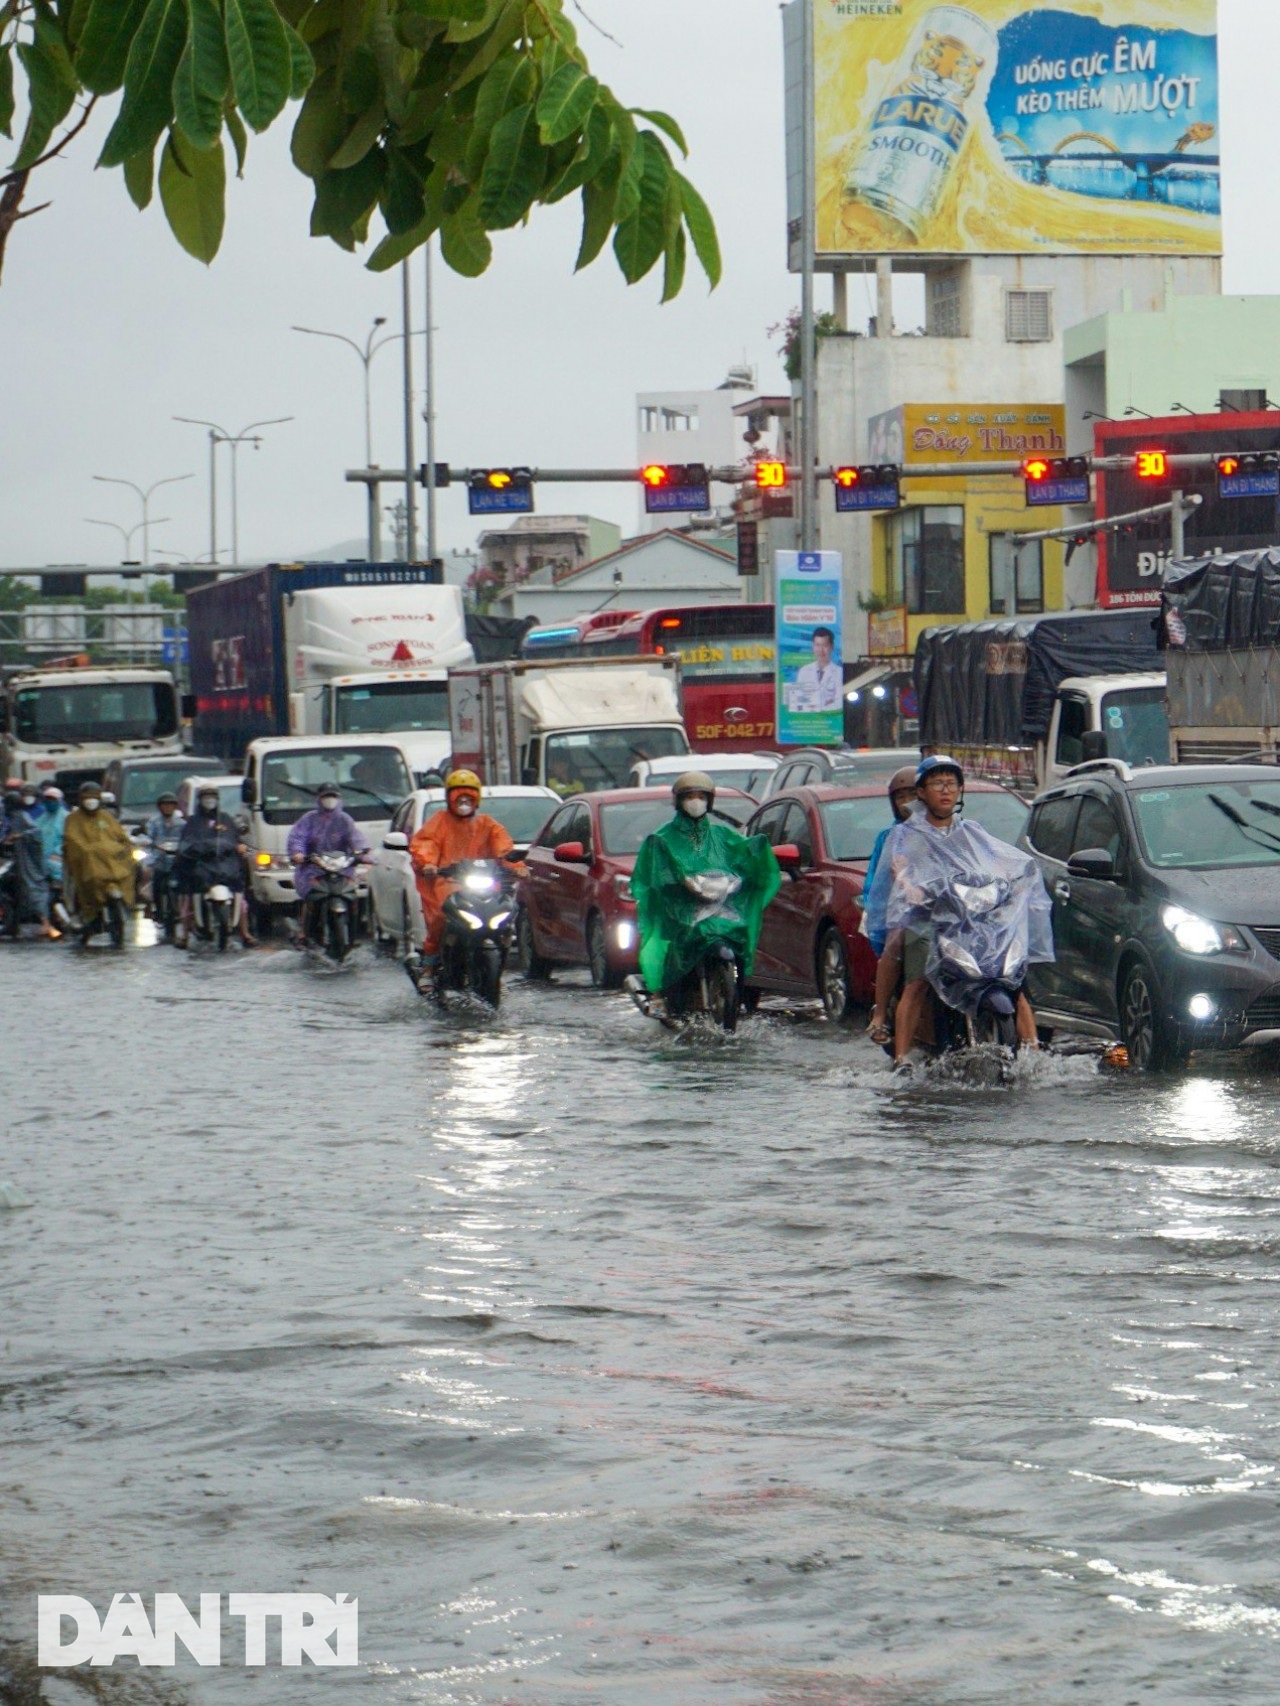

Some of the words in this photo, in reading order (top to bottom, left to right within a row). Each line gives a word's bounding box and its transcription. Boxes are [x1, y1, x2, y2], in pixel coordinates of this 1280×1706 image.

[836, 4, 903, 15] HEINEKEN
[1015, 54, 1067, 85] UỐNG
[1071, 51, 1110, 83] CỰC
[1114, 36, 1157, 75] ÊM
[1017, 87, 1052, 115] KÈO
[1055, 82, 1106, 111] THÊM
[1113, 73, 1201, 118] MƯỢT
[877, 100, 965, 146] LARUE
[868, 135, 950, 169] SMOOTH
[977, 427, 1066, 455] Thạnh
[757, 462, 784, 488] 30
[1138, 452, 1165, 477] 30
[680, 644, 723, 664] LIÊN
